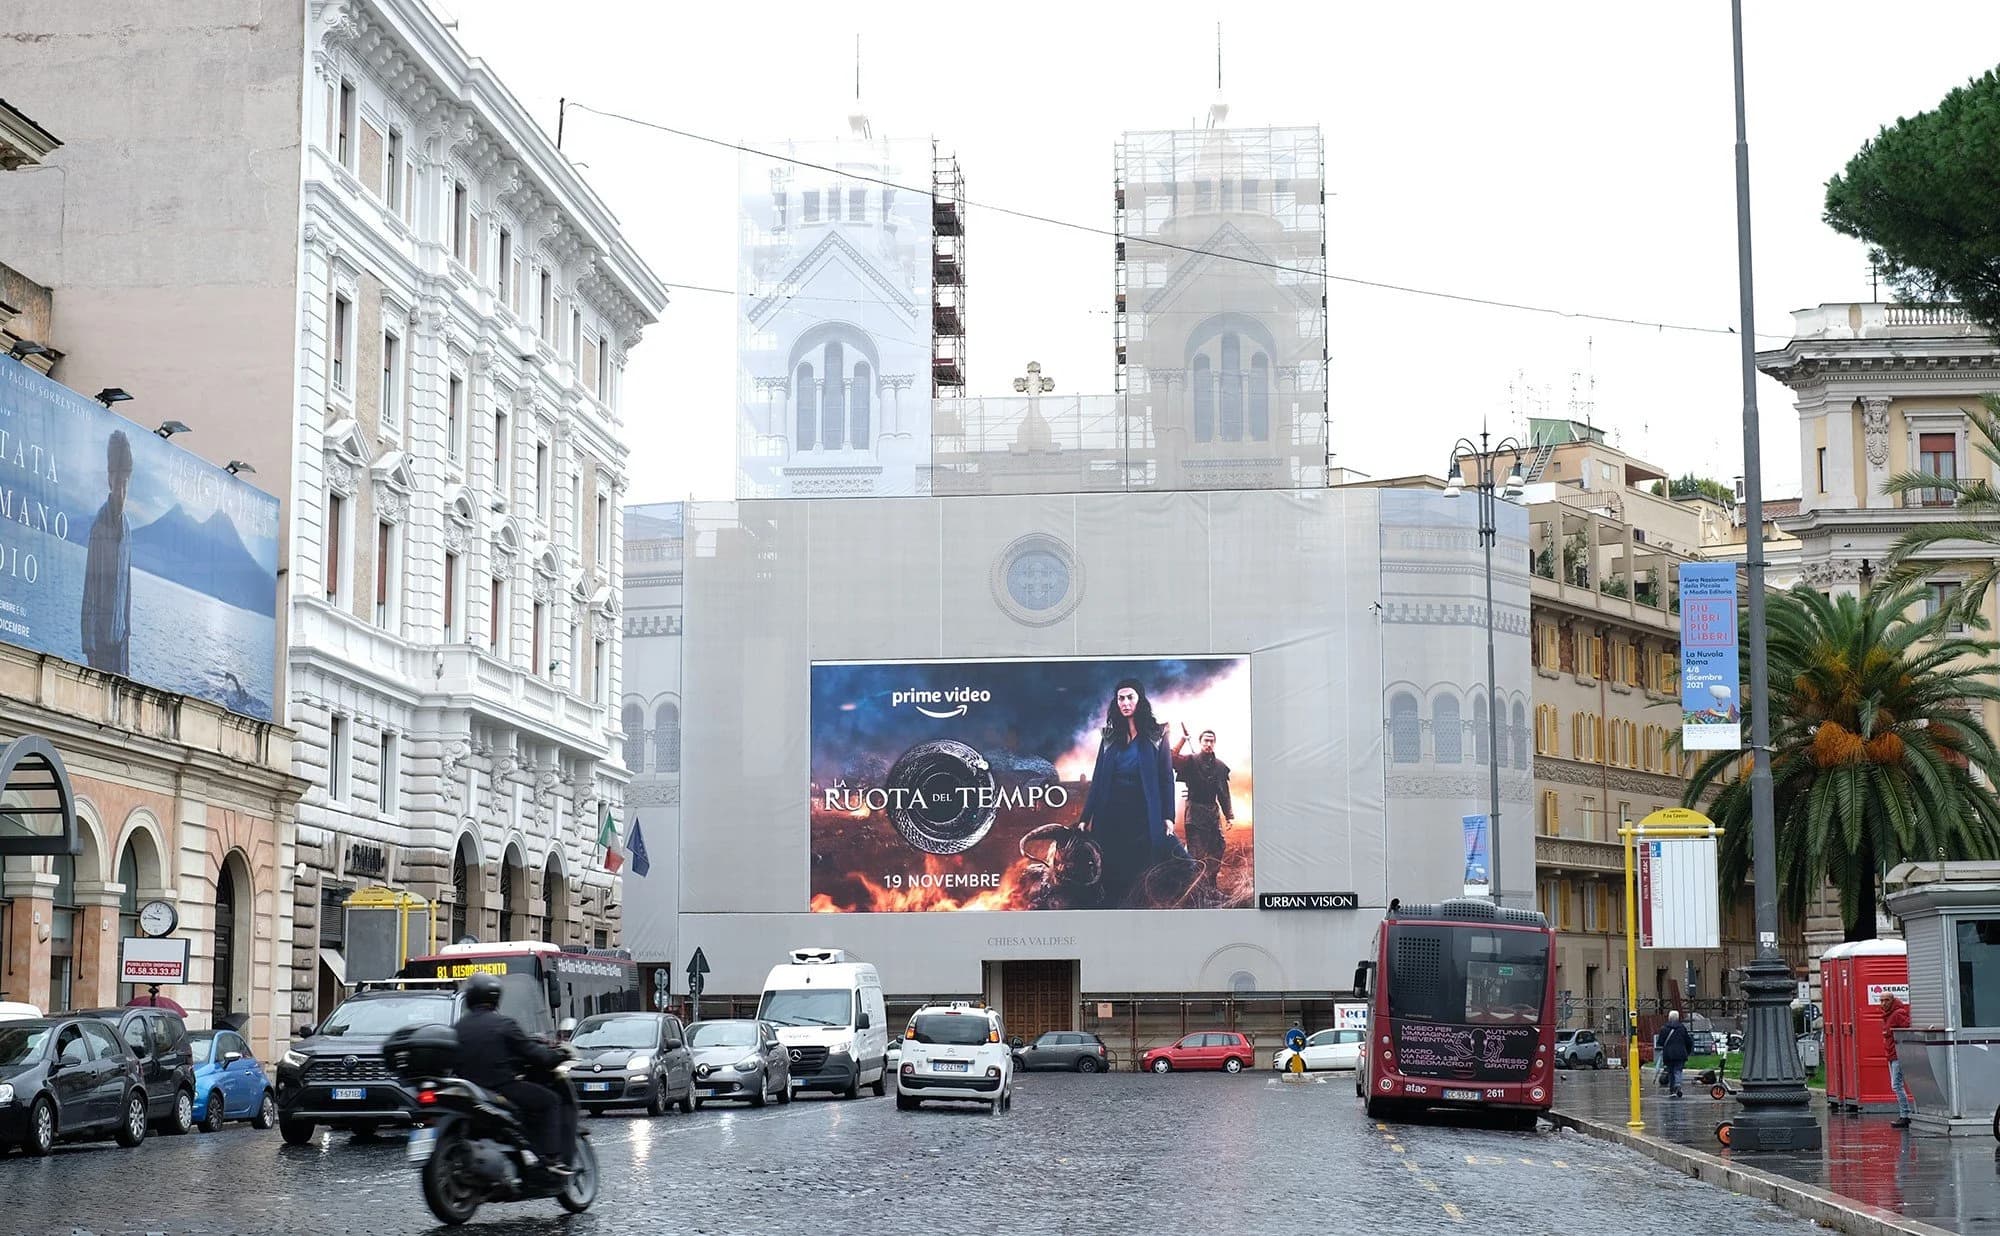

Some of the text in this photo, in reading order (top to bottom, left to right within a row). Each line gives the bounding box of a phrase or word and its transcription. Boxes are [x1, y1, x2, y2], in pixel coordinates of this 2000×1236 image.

[1686, 650, 1724, 658] La Nuvola
[1686, 658, 1709, 666] Roma
[1686, 681, 1704, 689] 2021
[892, 686, 991, 707] prime video
[834, 778, 847, 788] LA
[824, 788, 928, 811] RUOTA
[932, 793, 952, 802] DEL
[883, 873, 1001, 888] 19 NOVEMBRE
[1264, 896, 1353, 908] URBAN VISION
[986, 936, 1077, 946] CHIESA VALDESE
[436, 966, 449, 979] 81
[1485, 1029, 1529, 1037] AUTUNNO
[1405, 1083, 1427, 1093] atac
